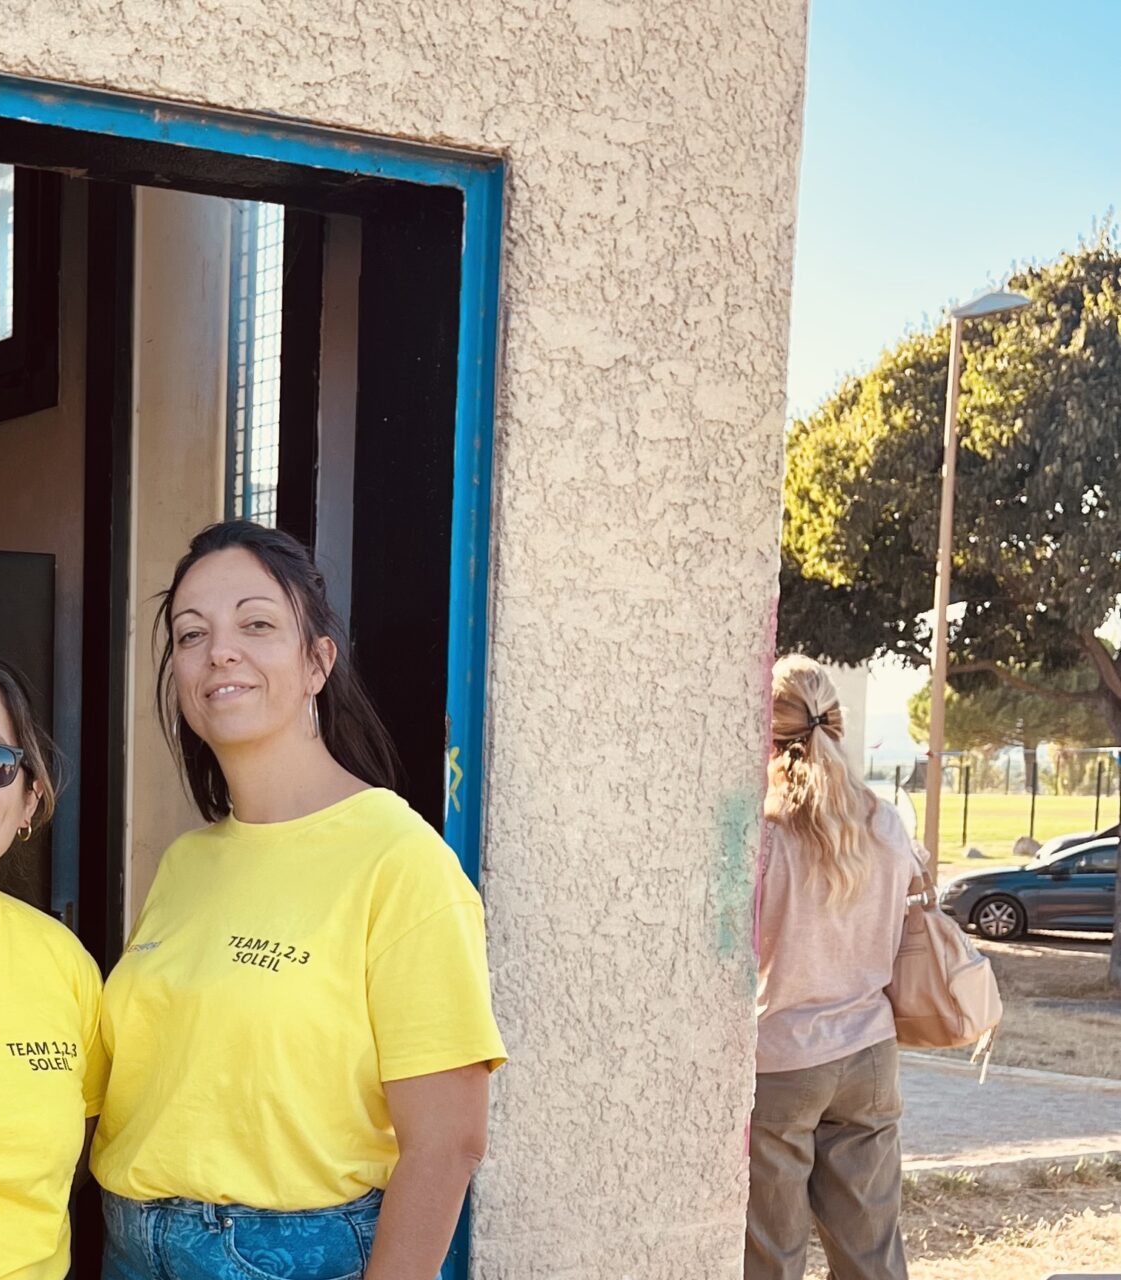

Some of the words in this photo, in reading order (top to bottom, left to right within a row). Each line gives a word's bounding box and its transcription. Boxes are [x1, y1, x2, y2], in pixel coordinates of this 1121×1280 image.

[228, 935, 270, 952] TEAM
[269, 941, 311, 965] 1,2,3
[231, 951, 281, 973] SOLEIL
[5, 1041, 51, 1057] TEAM
[51, 1041, 78, 1059] 1,2,3
[28, 1057, 74, 1072] SOLEIL
